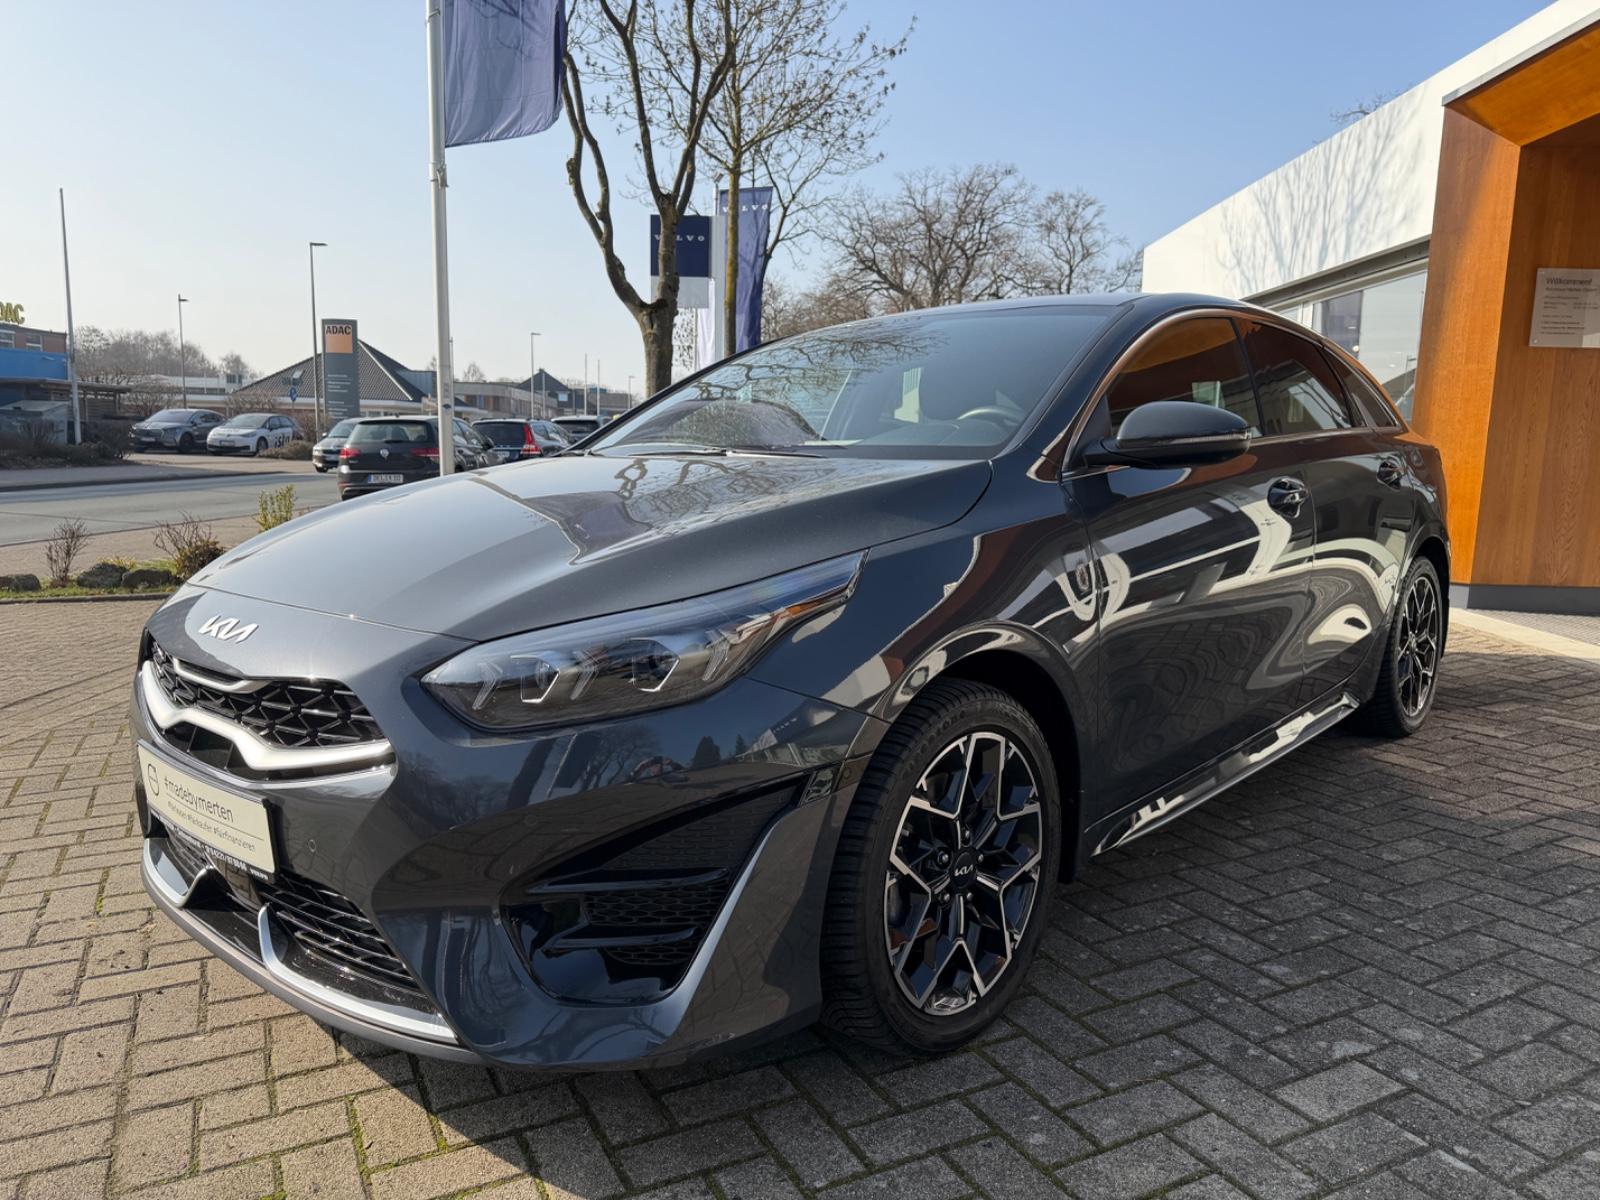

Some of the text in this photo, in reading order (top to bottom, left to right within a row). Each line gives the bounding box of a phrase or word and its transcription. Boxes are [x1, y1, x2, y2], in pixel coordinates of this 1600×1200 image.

[723, 204, 768, 213] VLVO
[654, 234, 705, 242] VLVO
[325, 325, 352, 335] ADAC
[198, 615, 259, 644] KIA
[164, 775, 234, 823] #madebymerten
